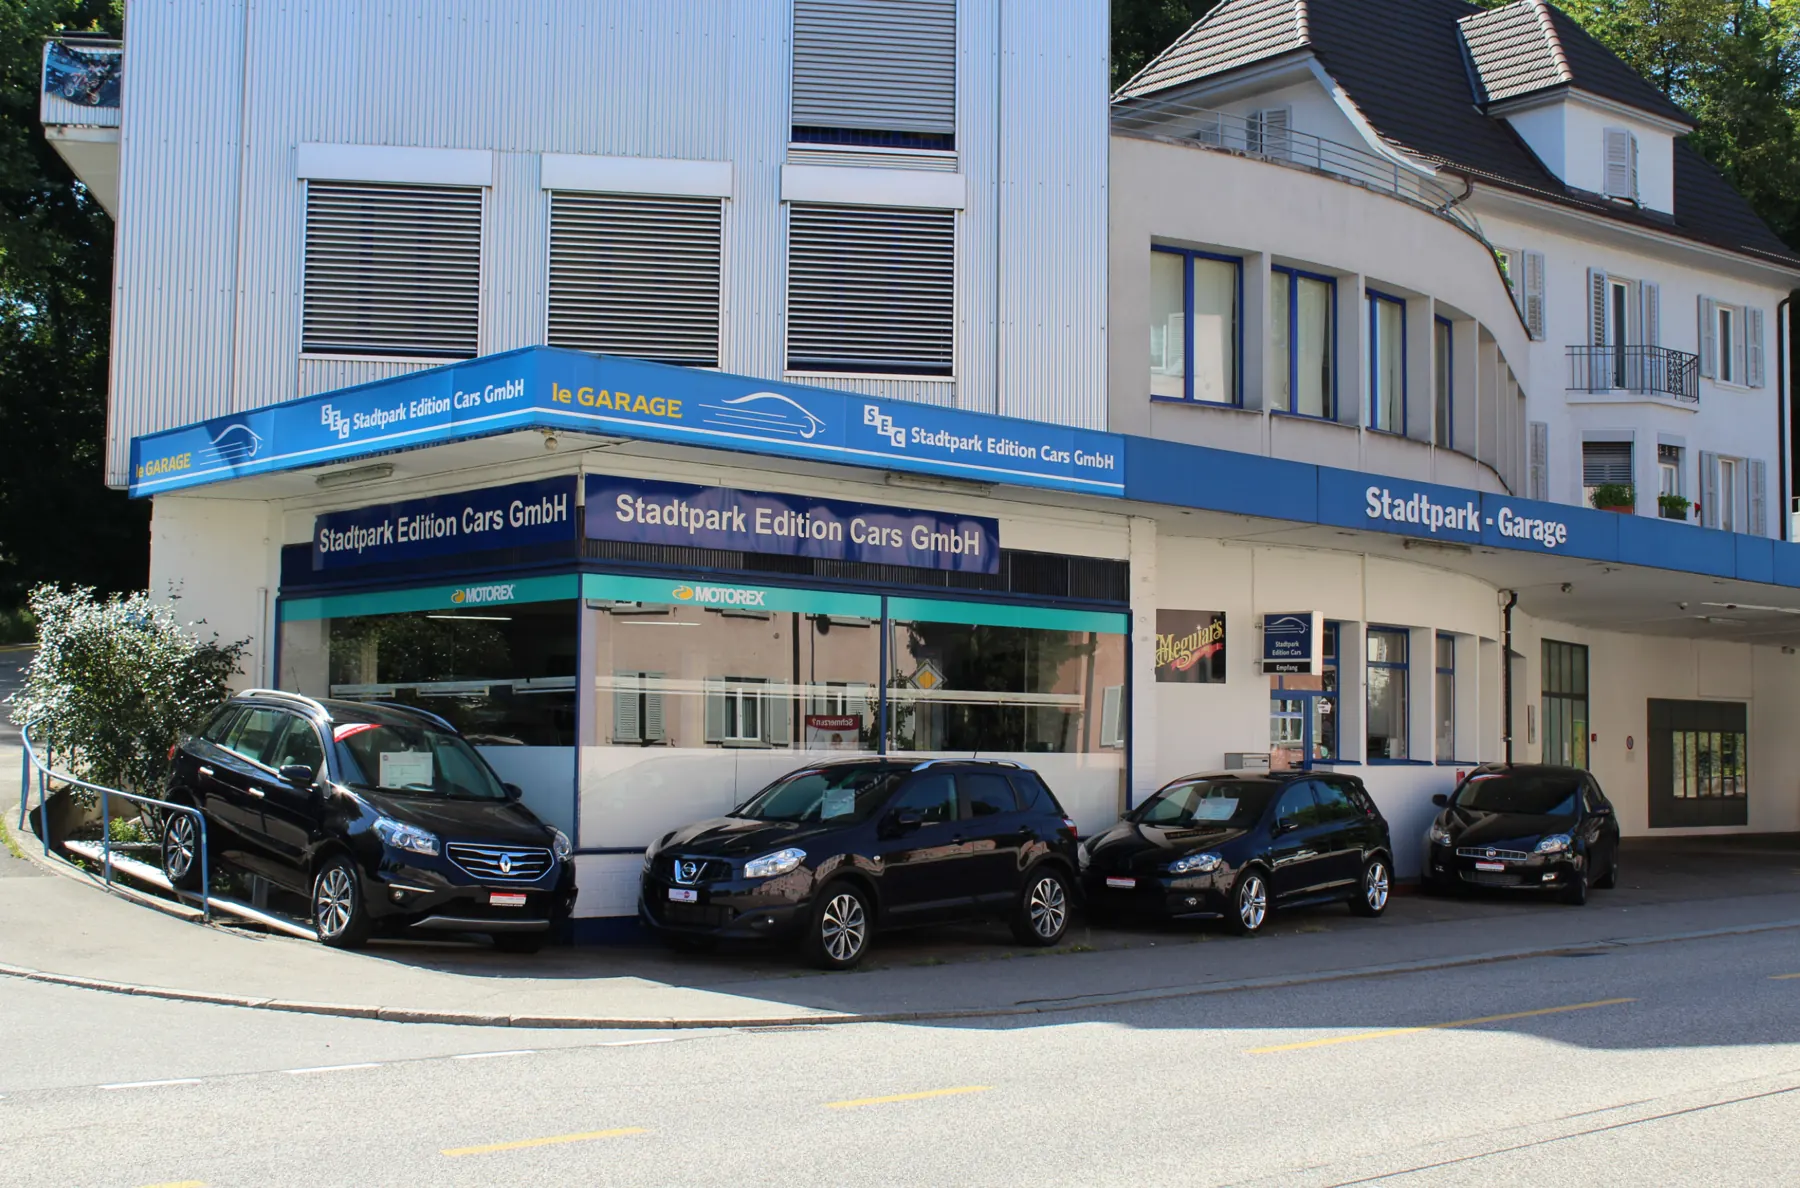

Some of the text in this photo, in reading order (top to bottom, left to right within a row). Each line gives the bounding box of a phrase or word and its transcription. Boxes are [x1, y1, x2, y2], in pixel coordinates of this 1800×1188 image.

[353, 402, 407, 430] Stadtpark
[410, 396, 450, 418] Edition
[453, 391, 481, 409] Cars
[484, 378, 524, 404] GmbH
[552, 382, 683, 418] le GARAGE
[136, 452, 192, 479] le GARAGE
[911, 427, 982, 453] Stadtpark
[987, 438, 1037, 460] Edition
[1040, 445, 1070, 464] Cars
[1074, 450, 1114, 470] GmbH
[319, 493, 567, 554] Stadtpark Edition Cars GmbH
[616, 493, 980, 556] Stadtpark Edition Cars GmbH
[1365, 486, 1481, 533] Stadtpark
[1498, 507, 1567, 548] Garage
[465, 584, 514, 603] MOTOREX
[695, 586, 765, 606] MOTOREX
[1156, 619, 1223, 668] Meguiar's
[1275, 641, 1299, 649] Stadtpark
[1276, 664, 1299, 672] Empfang
